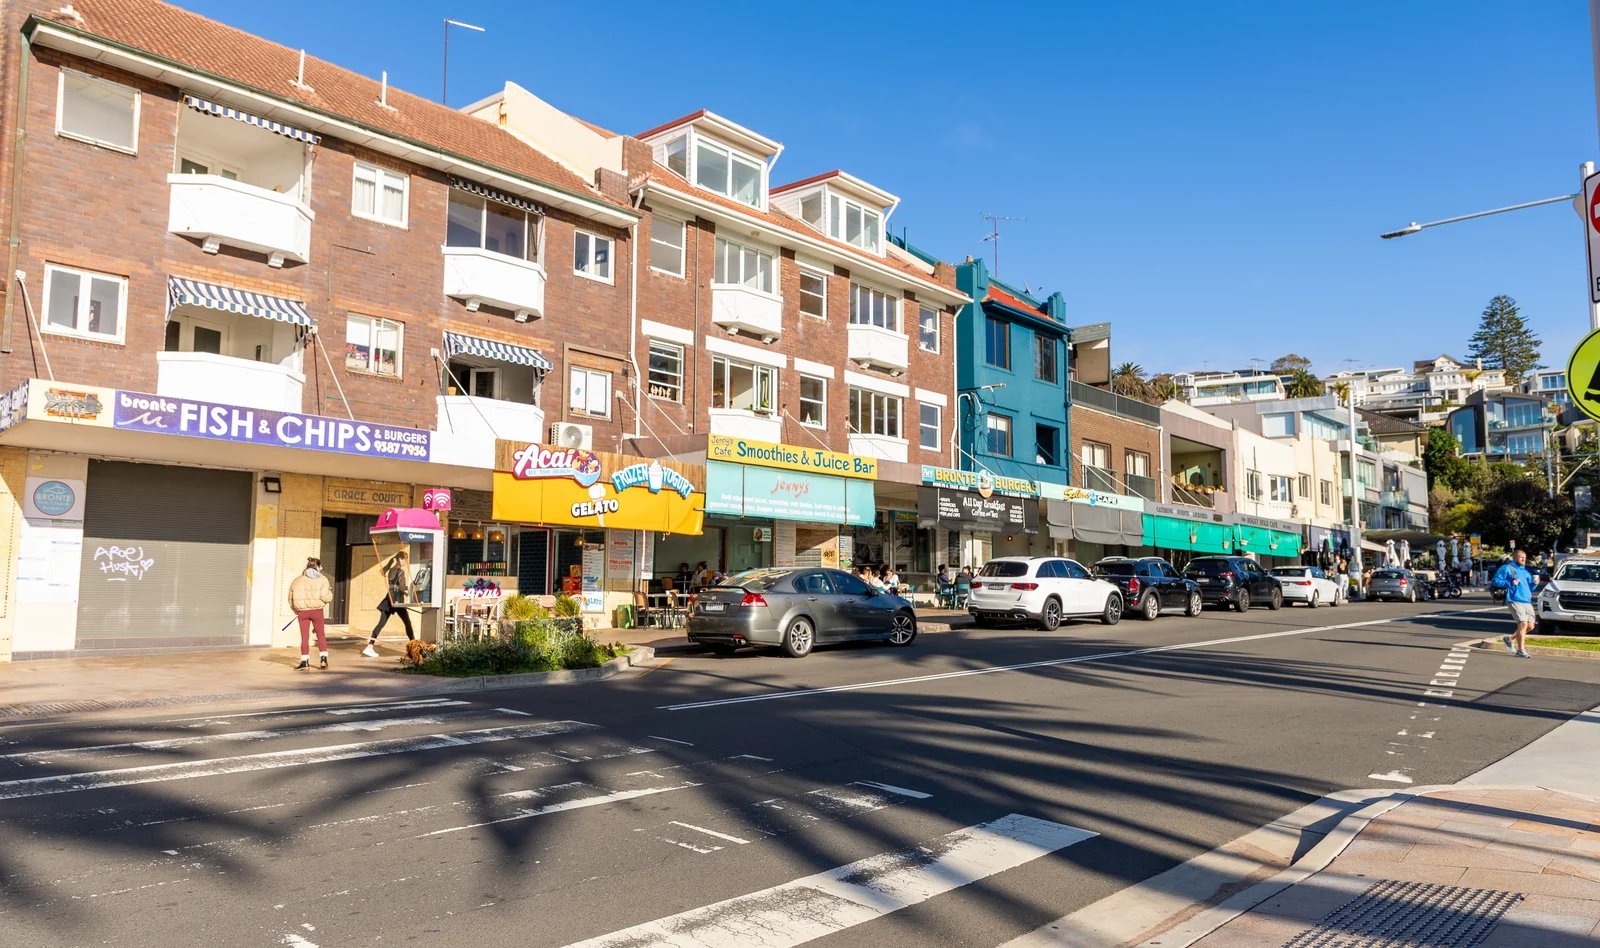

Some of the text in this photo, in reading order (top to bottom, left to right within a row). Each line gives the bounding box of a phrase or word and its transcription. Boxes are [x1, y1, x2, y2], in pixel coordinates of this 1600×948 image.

[121, 393, 177, 413] bronte
[180, 402, 371, 452] FISH & CHIPS
[374, 429, 428, 445] & BURGERS
[711, 435, 733, 446] Jenny's
[514, 444, 573, 477] Acai
[714, 447, 732, 456] Cafe
[737, 440, 874, 475] Smoothies & Juice Bar
[612, 463, 695, 498] FROZEN YOGURT
[935, 468, 976, 486] BRONTE
[995, 477, 1038, 494] BURGERS
[36, 492, 72, 502] BRONTE
[333, 489, 404, 504] GRACE COURT
[1096, 495, 1118, 504] CAFE
[571, 499, 619, 517] GELATO
